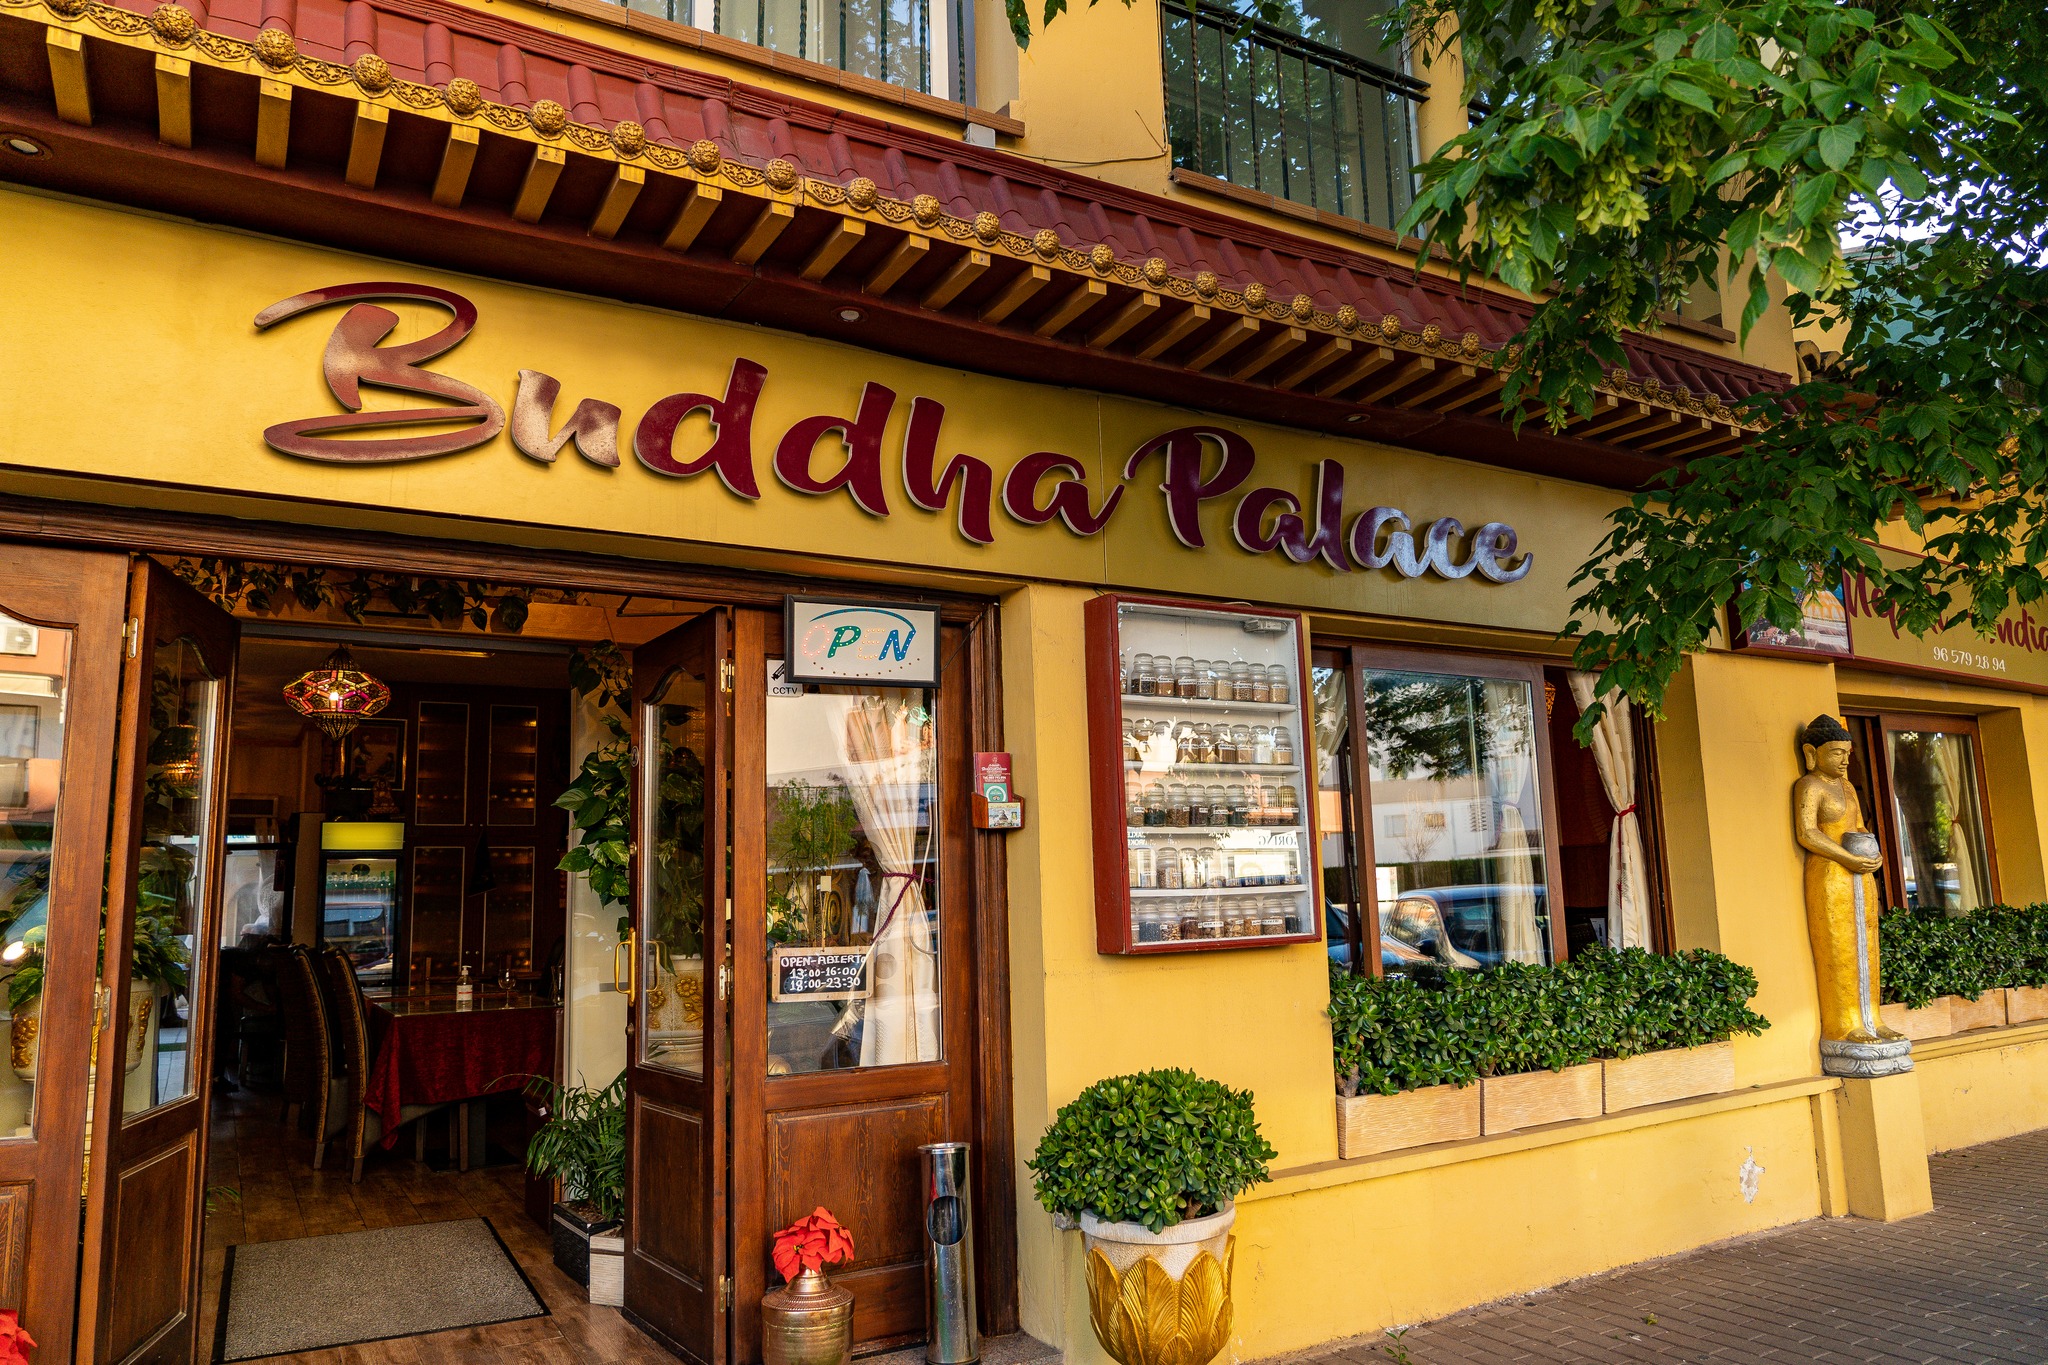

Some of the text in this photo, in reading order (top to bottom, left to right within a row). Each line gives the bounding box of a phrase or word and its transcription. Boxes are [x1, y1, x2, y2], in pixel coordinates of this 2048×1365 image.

[253, 280, 1533, 584] Buddha Palace
[802, 622, 917, 662] OPEN
[1933, 646, 2006, 672] 96 579 28 94
[772, 686, 798, 695] CCTV
[789, 967, 857, 980] 13:00-16:00
[789, 976, 861, 992] 18:00-23:30
